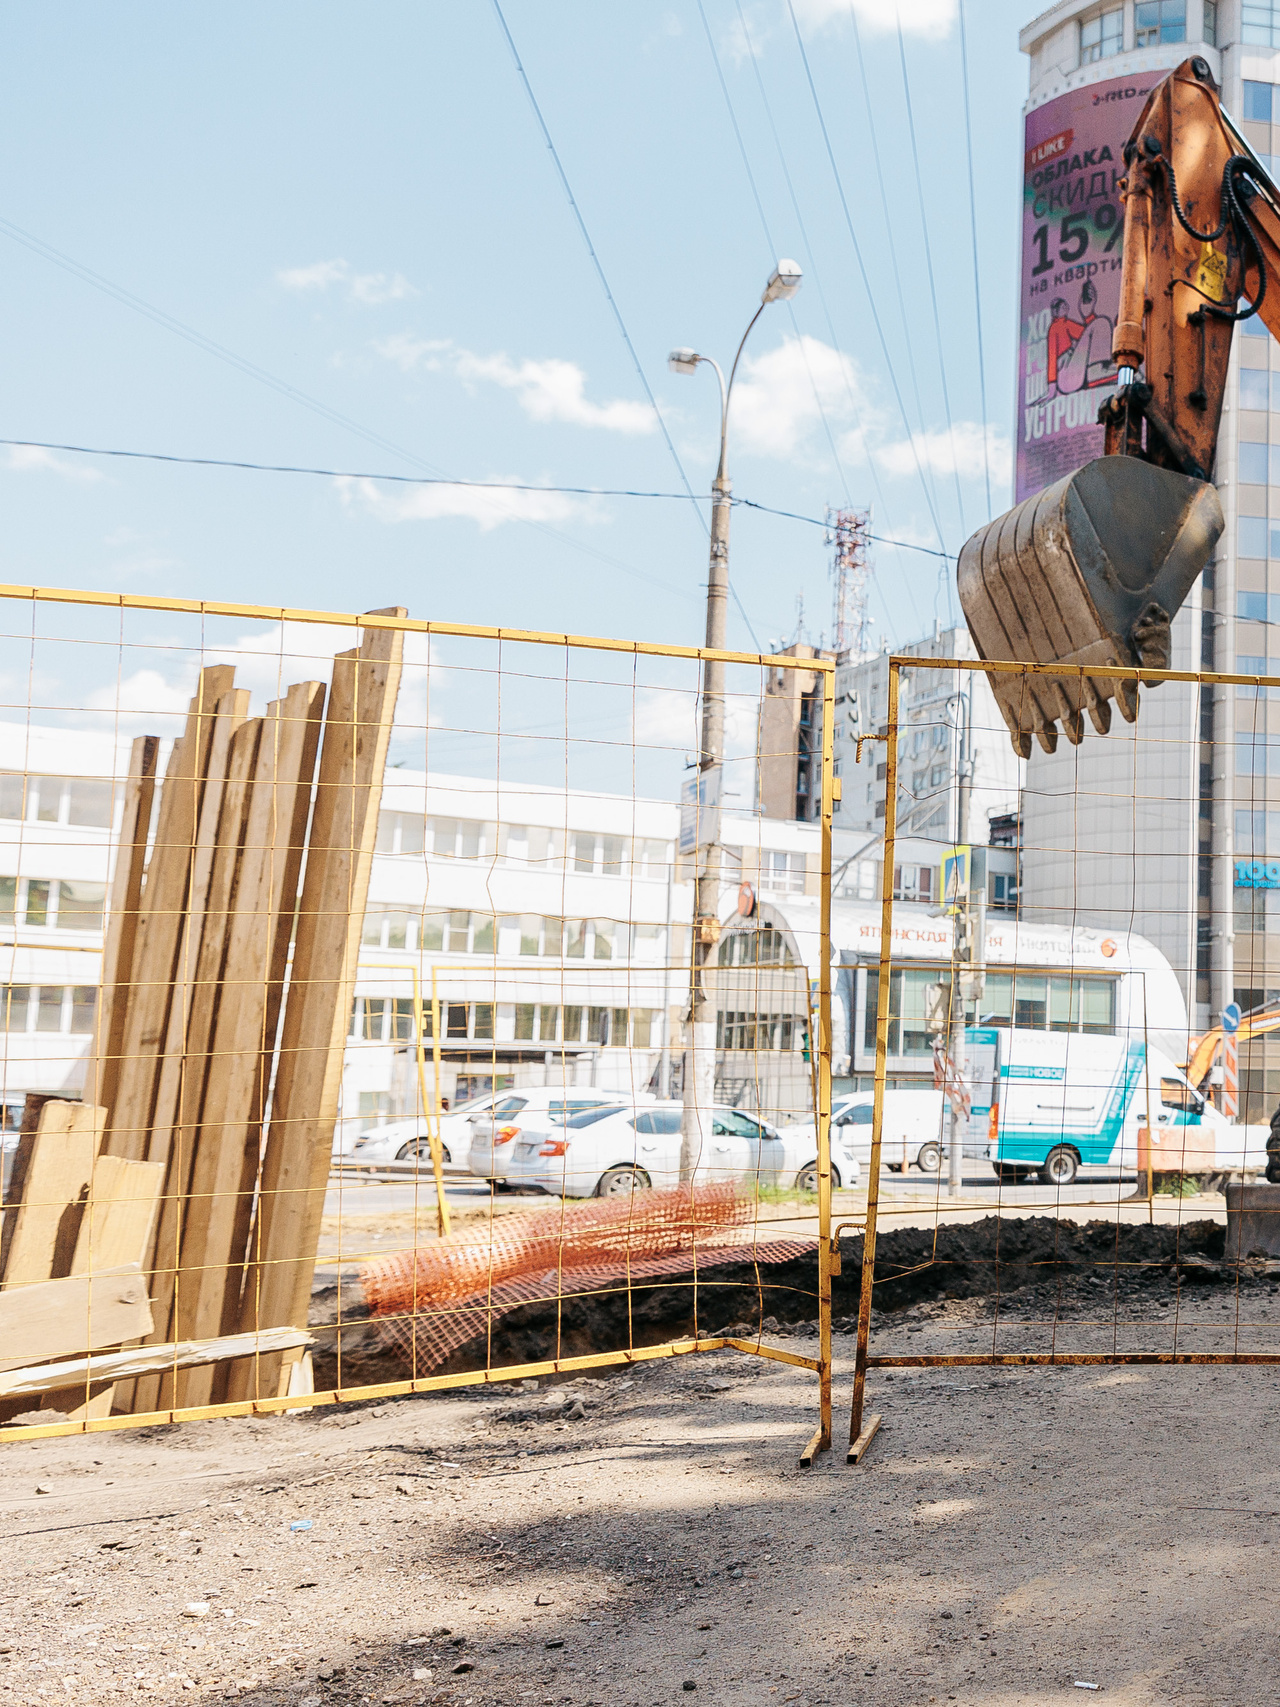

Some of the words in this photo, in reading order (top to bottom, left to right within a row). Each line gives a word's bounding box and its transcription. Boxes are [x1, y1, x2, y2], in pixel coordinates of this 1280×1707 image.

[1038, 136, 1066, 161] LIKE
[1032, 145, 1114, 187] ОБЛАКА
[1030, 279, 1048, 297] на
[860, 926, 947, 943] ЯПНСКАЯ
